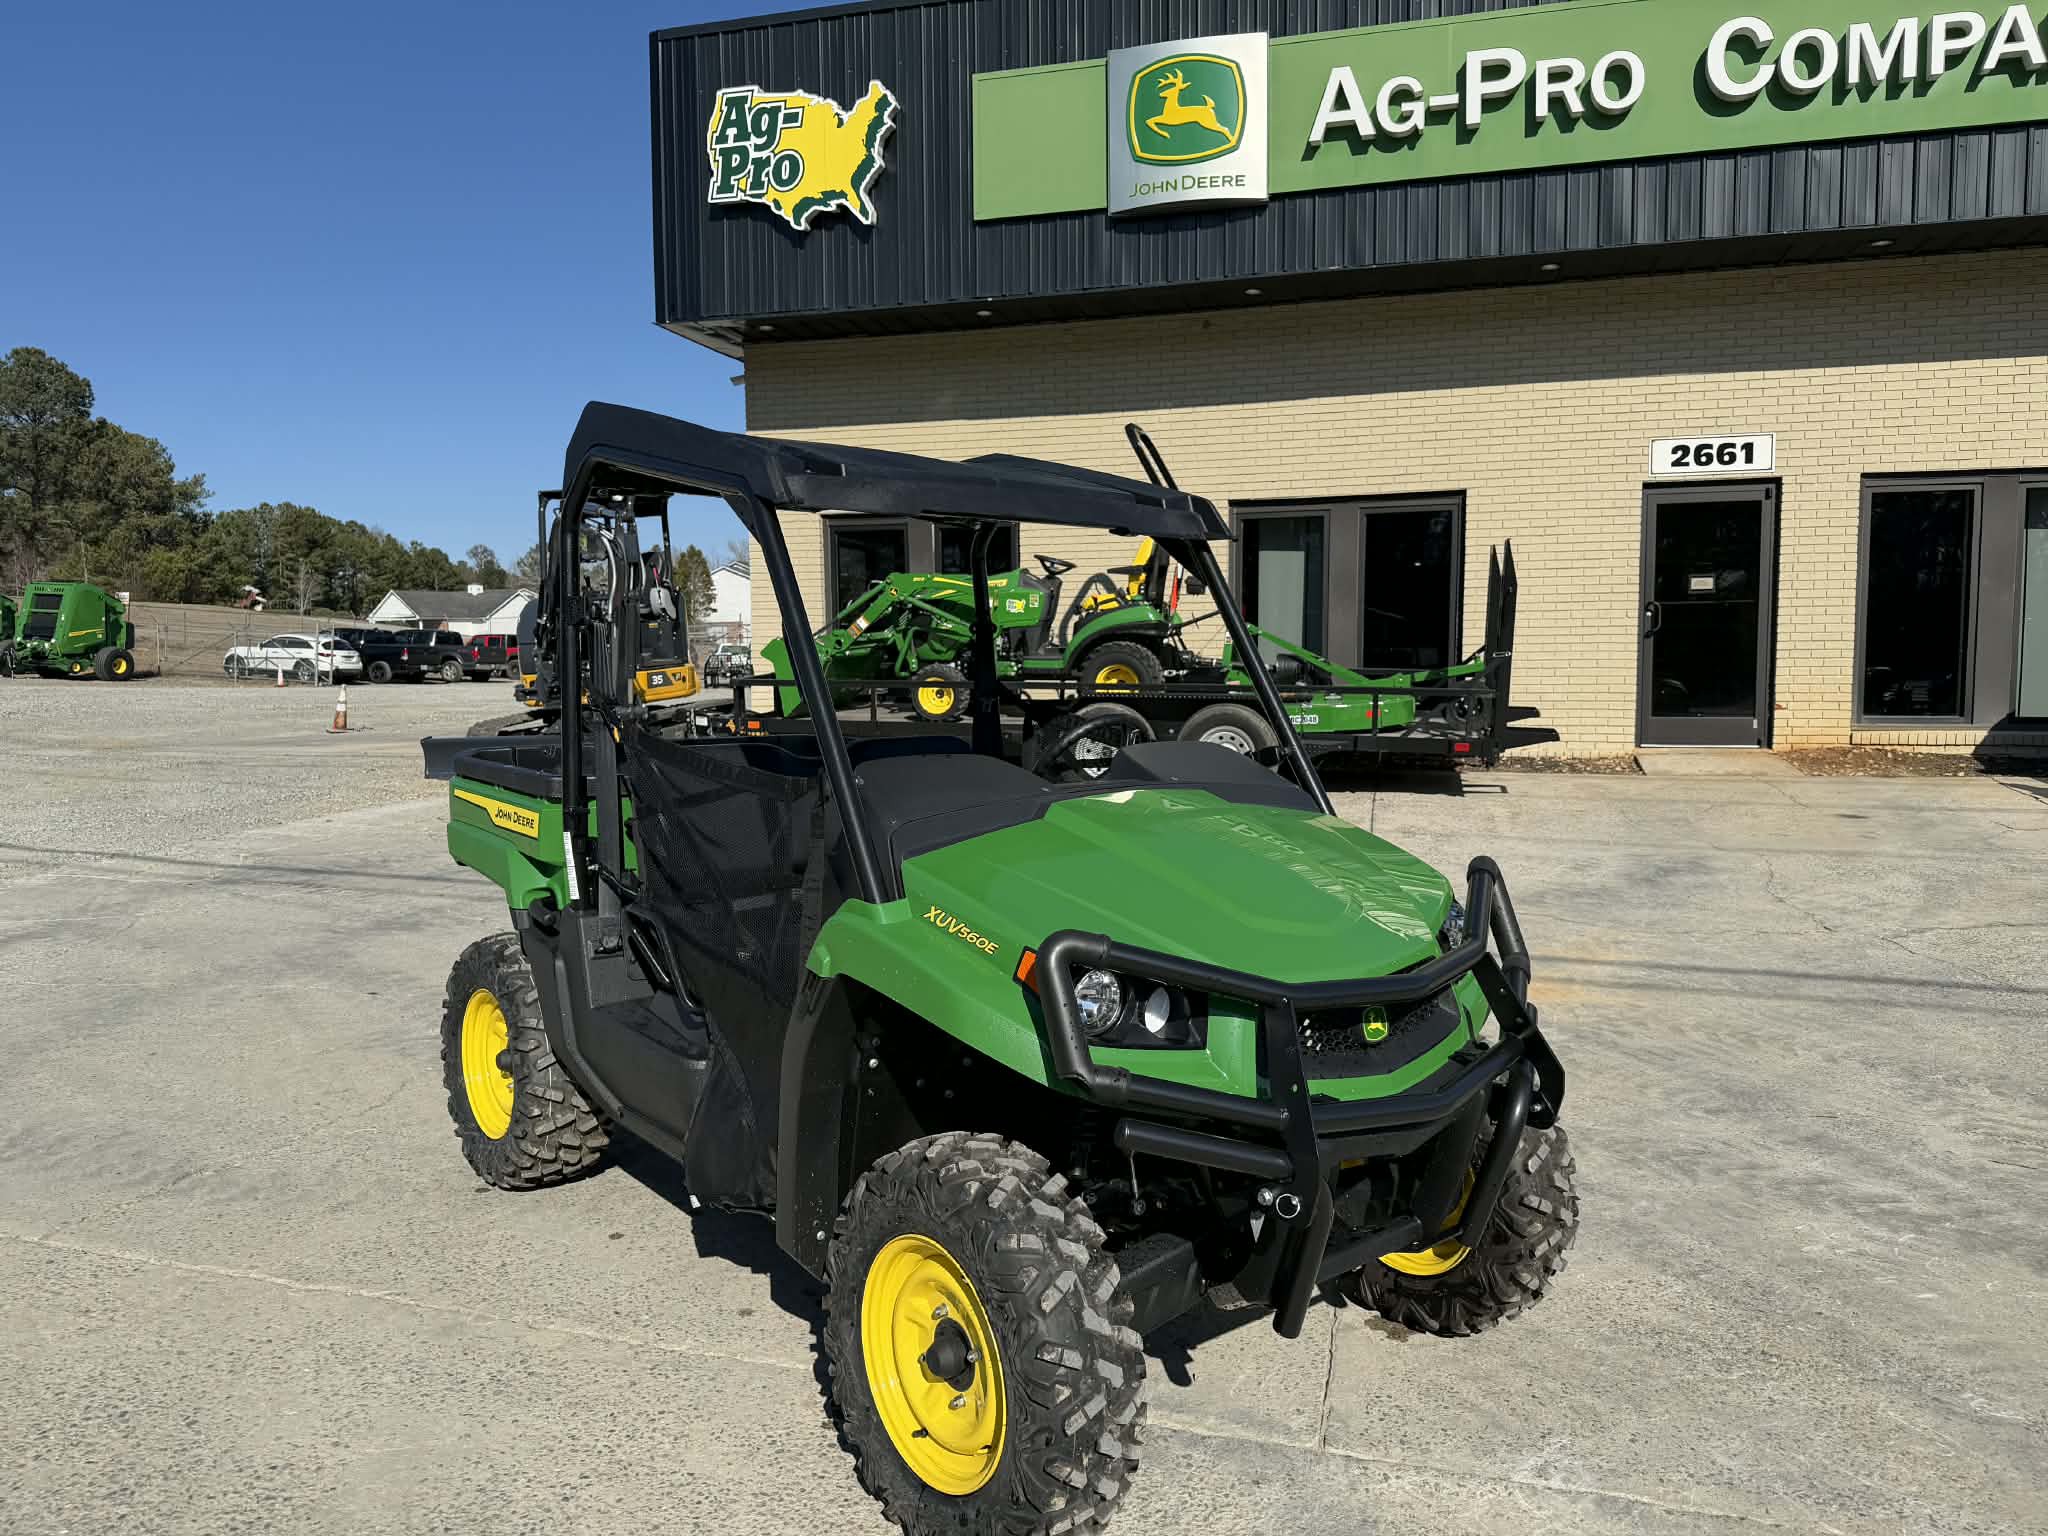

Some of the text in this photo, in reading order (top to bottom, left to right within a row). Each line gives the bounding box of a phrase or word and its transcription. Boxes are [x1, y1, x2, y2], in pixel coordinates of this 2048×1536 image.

[713, 91, 803, 152] Ag-
[713, 144, 803, 199] Pro
[1129, 175, 1247, 198] JOHN DEERE
[1670, 442, 1754, 467] 2661
[651, 674, 664, 685] 35
[494, 807, 535, 829] JOHN DEERE
[923, 905, 999, 955] XUV560E
